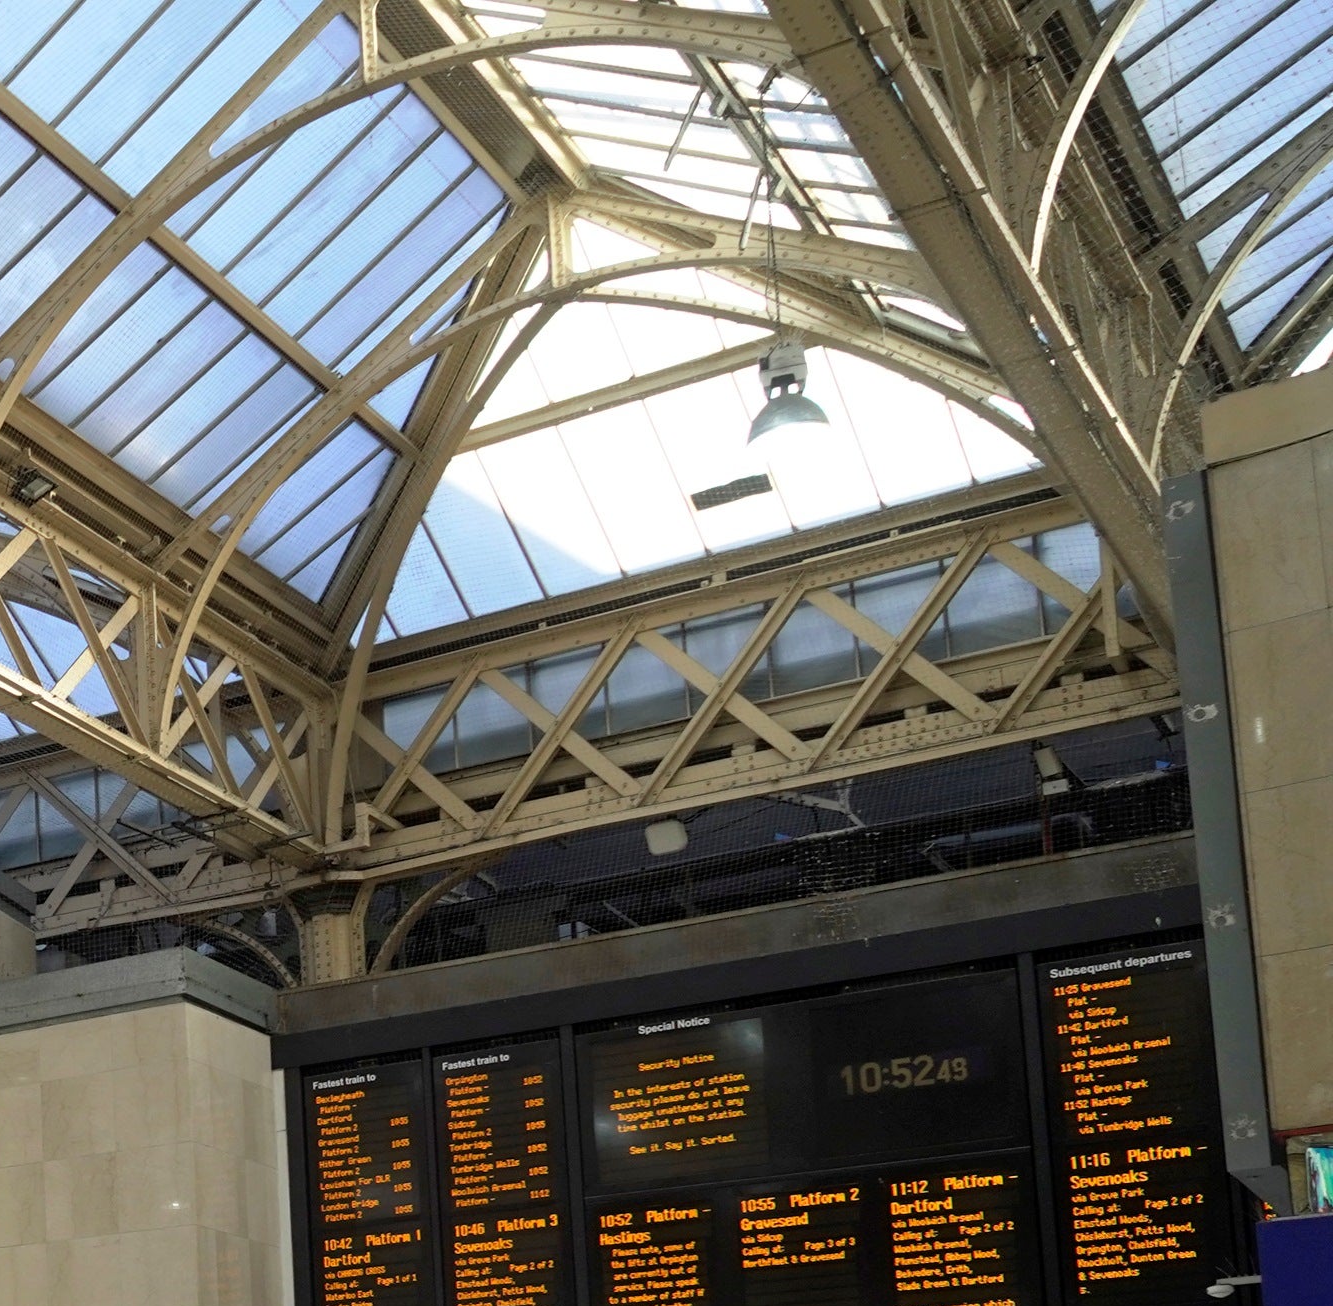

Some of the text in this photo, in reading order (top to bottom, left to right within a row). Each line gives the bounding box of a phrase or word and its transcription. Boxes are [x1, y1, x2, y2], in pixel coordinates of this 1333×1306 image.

[1050, 950, 1192, 979] Subsequent departures
[638, 1016, 710, 1035] Special Notice
[442, 1058, 475, 1070] Fastest
[477, 1056, 498, 1065] train
[638, 1054, 714, 1072] Security Notice
[312, 1078, 344, 1090] Fastest
[345, 1076, 365, 1085] train
[841, 1055, 935, 1095] 10:52
[1070, 1146, 1191, 1169] 11:16 Platform
[891, 1175, 1003, 1196] 11:12 Platform
[1070, 1170, 1149, 1189] Sevenoaks
[789, 1192, 845, 1207] Platform
[849, 1188, 860, 1201] 2
[891, 1197, 953, 1215] Dartford
[646, 1208, 698, 1223] Platform
[741, 1212, 809, 1231] Gravesend
[455, 1214, 558, 1237] 10:46 Platform 3
[324, 1229, 421, 1251] 10:42 Platform 1
[454, 1238, 513, 1254] Sevenoaks
[599, 1231, 651, 1246] Hastings
[323, 1252, 371, 1268] Dartford
